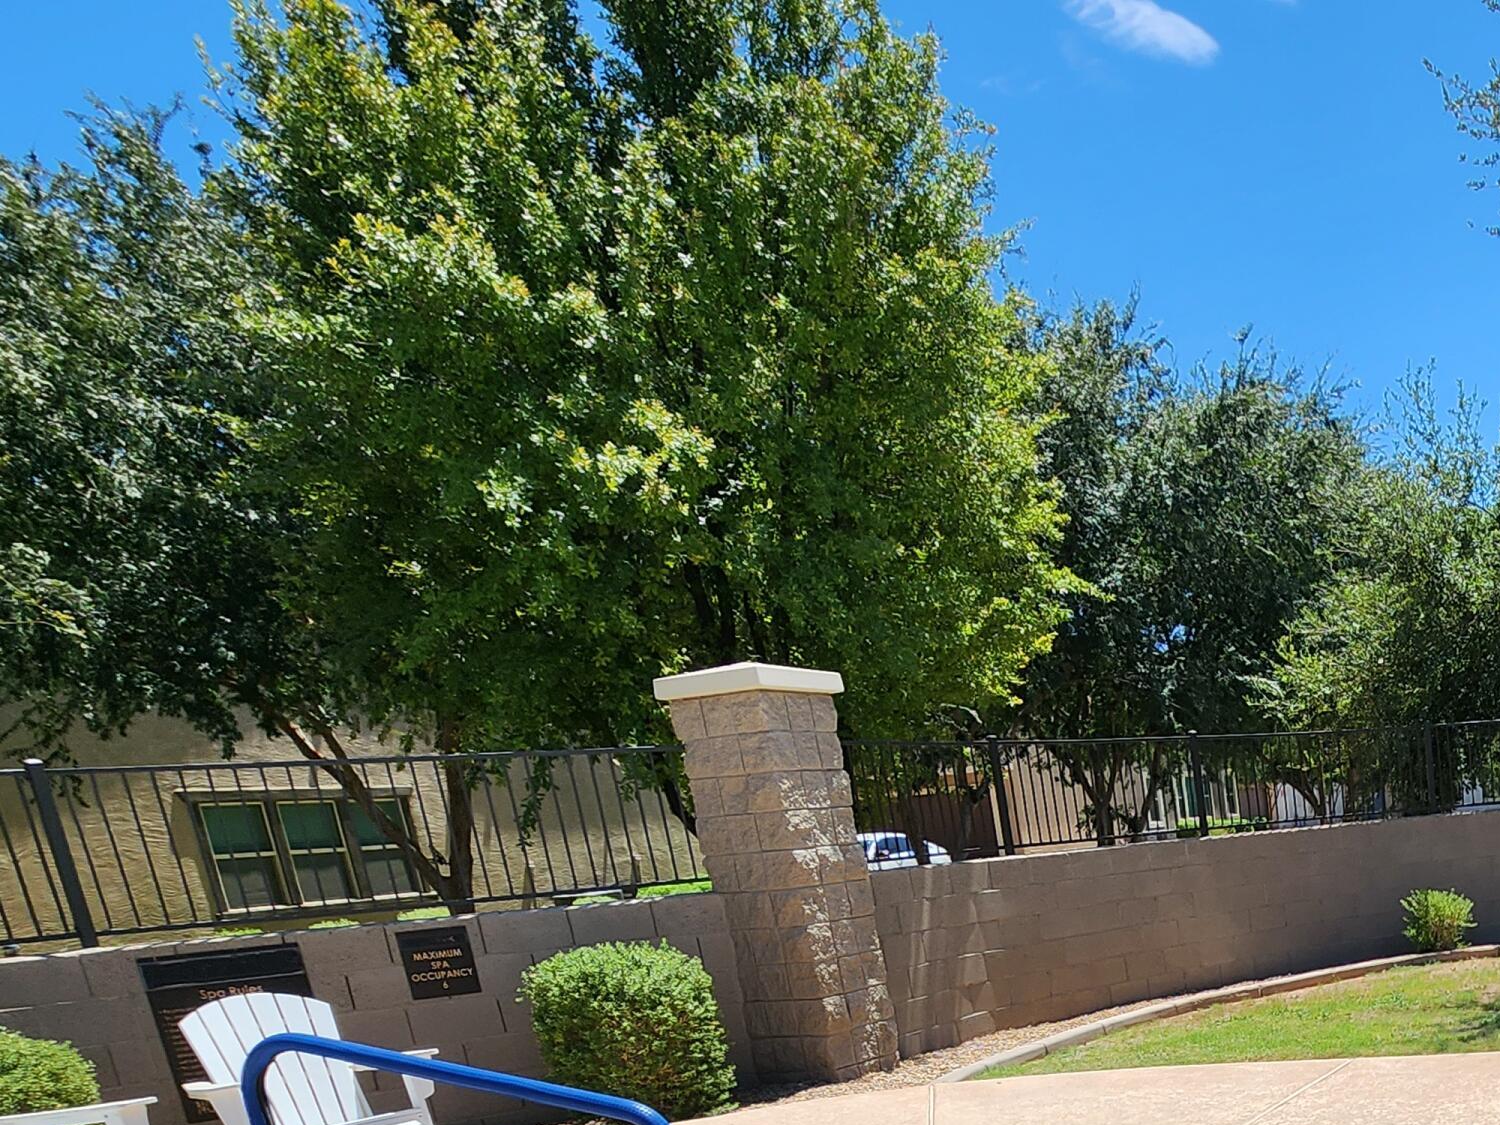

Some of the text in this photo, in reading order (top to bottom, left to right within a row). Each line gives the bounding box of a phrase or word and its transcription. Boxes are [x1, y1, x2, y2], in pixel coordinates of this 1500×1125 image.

[412, 948, 463, 961] MAXIMUM
[430, 960, 450, 970] SPA
[410, 967, 473, 983] OCCUPANCY
[442, 981, 449, 989] 6
[199, 984, 264, 1001] Spa Rules
